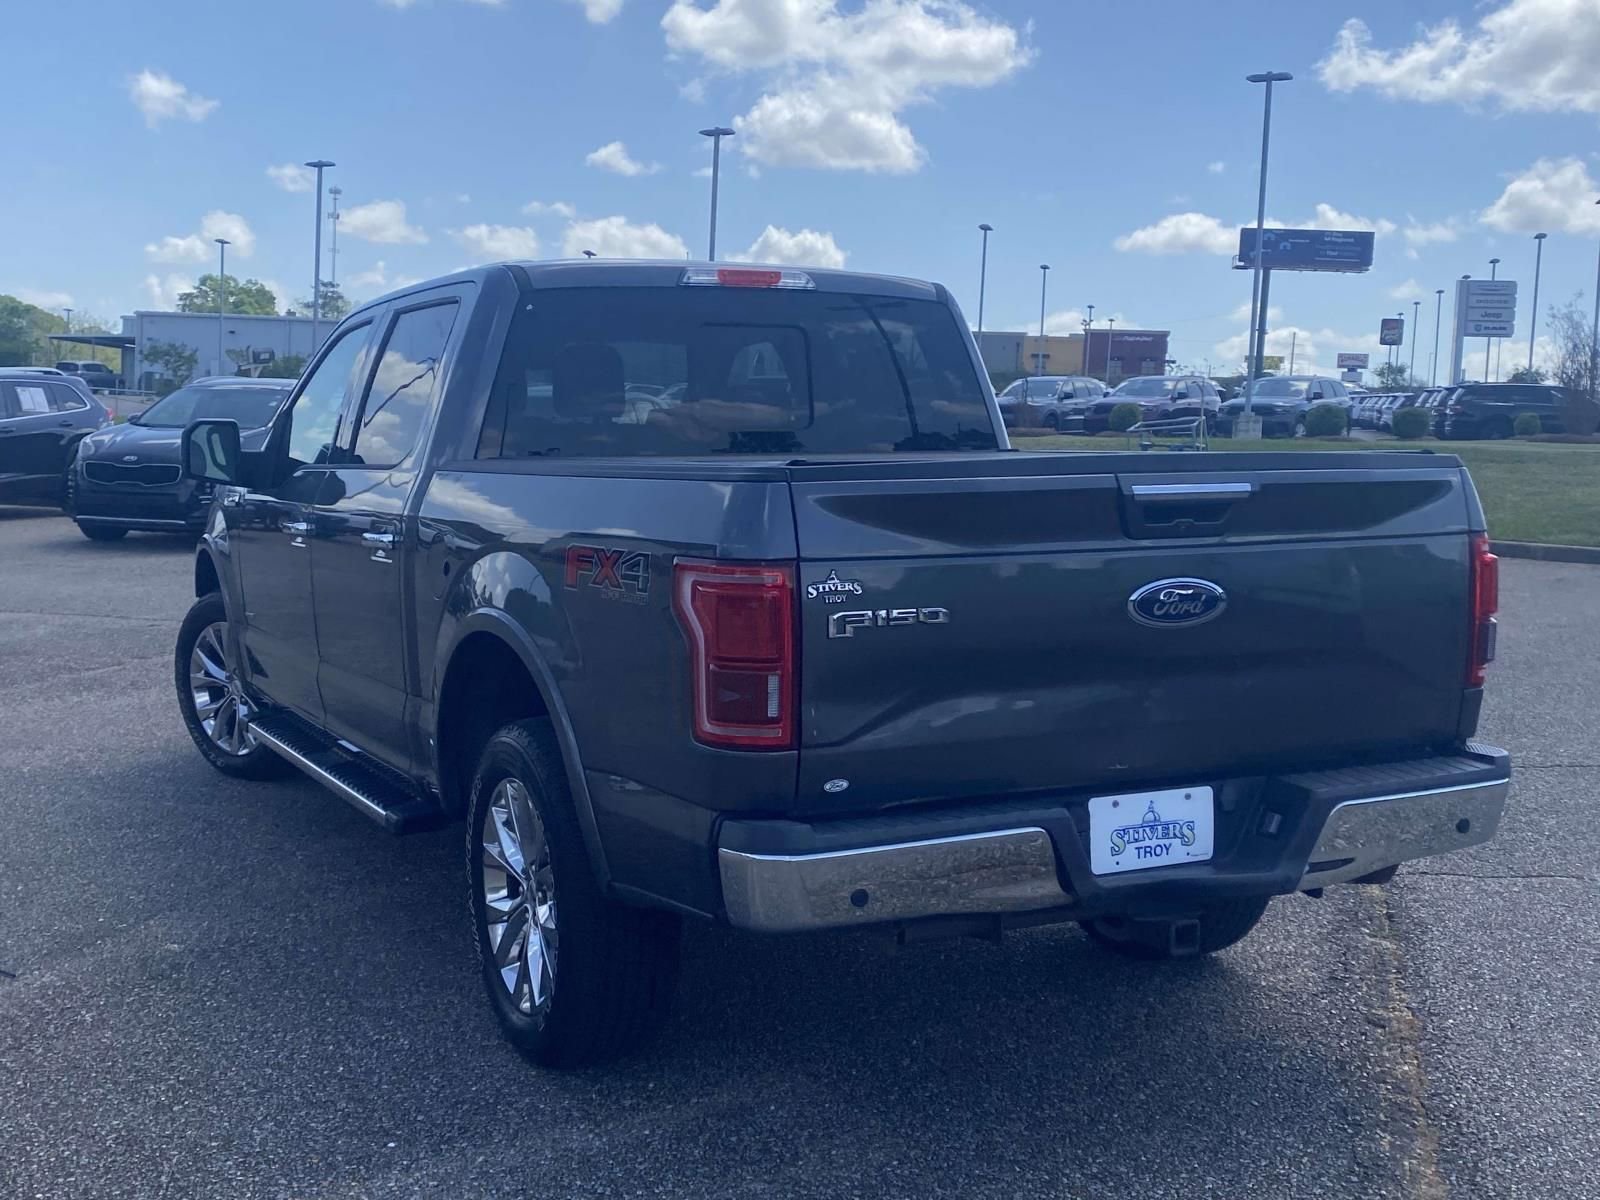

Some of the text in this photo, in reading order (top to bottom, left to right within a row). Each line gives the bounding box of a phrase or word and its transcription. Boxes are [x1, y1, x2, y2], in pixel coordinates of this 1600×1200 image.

[564, 543, 651, 595] FX4
[807, 582, 863, 599] STIVERS
[824, 594, 847, 603] TROY
[1153, 588, 1206, 616] Ford
[828, 607, 950, 639] F150
[1110, 820, 1196, 856] STIVERS
[1135, 843, 1173, 859] TROY
